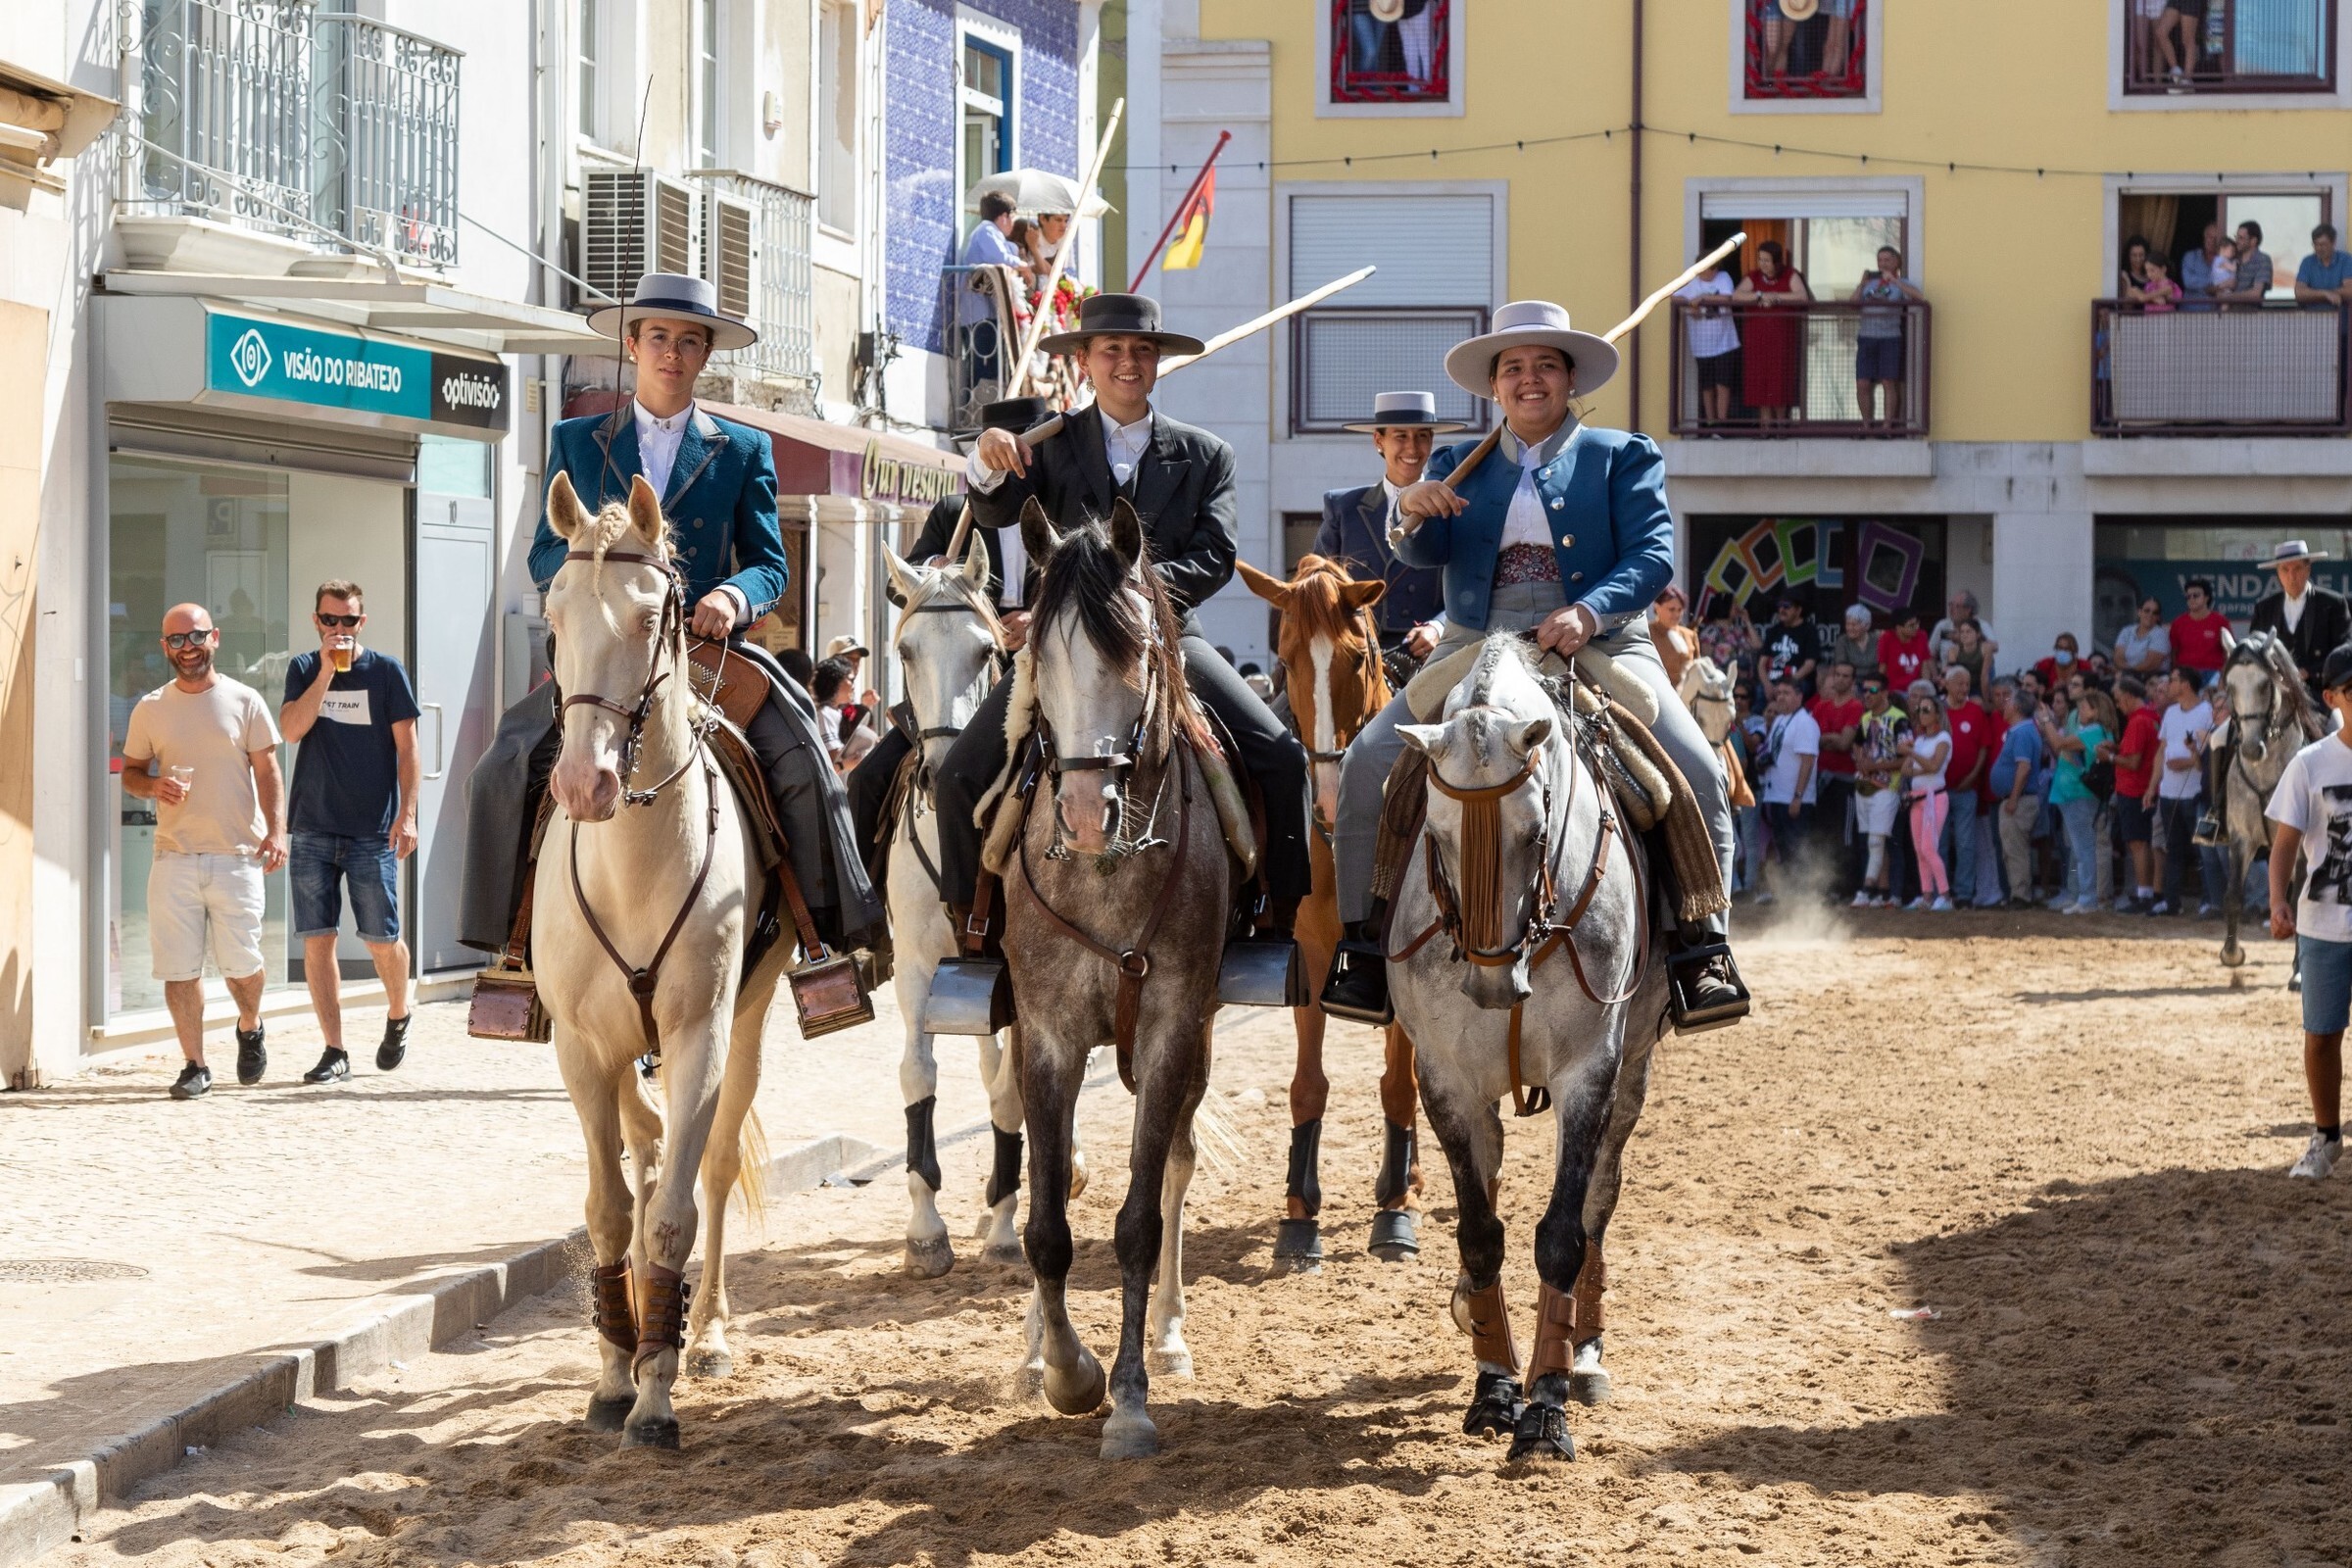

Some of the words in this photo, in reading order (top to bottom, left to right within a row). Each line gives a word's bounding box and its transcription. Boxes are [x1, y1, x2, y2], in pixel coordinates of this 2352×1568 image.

[283, 346, 322, 383] VISÃO
[324, 357, 344, 386] DO
[345, 359, 402, 394] RIBATEJO
[442, 371, 500, 411] optivisão
[449, 500, 458, 524] 10
[2218, 602, 2256, 616] garag
